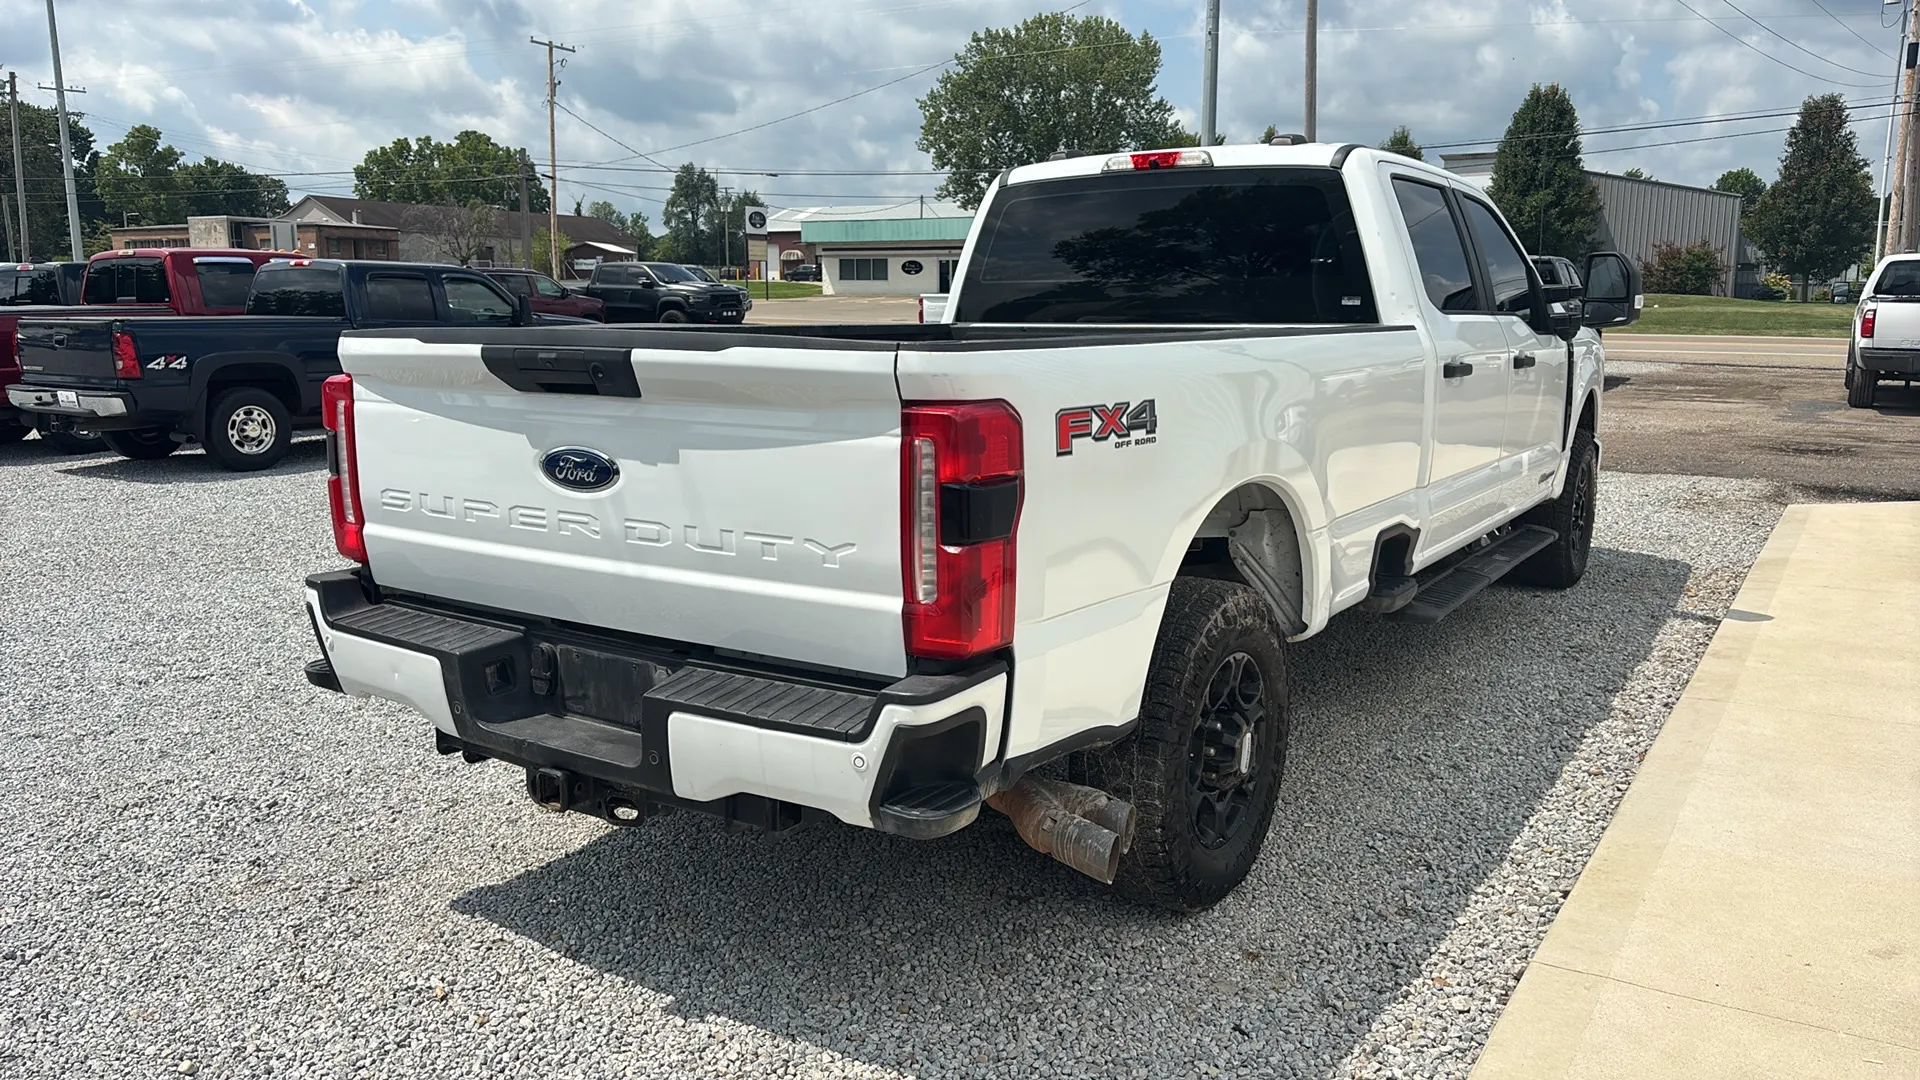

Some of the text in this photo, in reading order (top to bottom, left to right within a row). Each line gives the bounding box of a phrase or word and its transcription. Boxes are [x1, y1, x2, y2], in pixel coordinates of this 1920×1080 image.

[1055, 399, 1157, 457] FX4
[1114, 436, 1157, 449] OFF ROAD
[555, 454, 598, 483] Ford
[380, 487, 857, 568] SUPER DUTY
